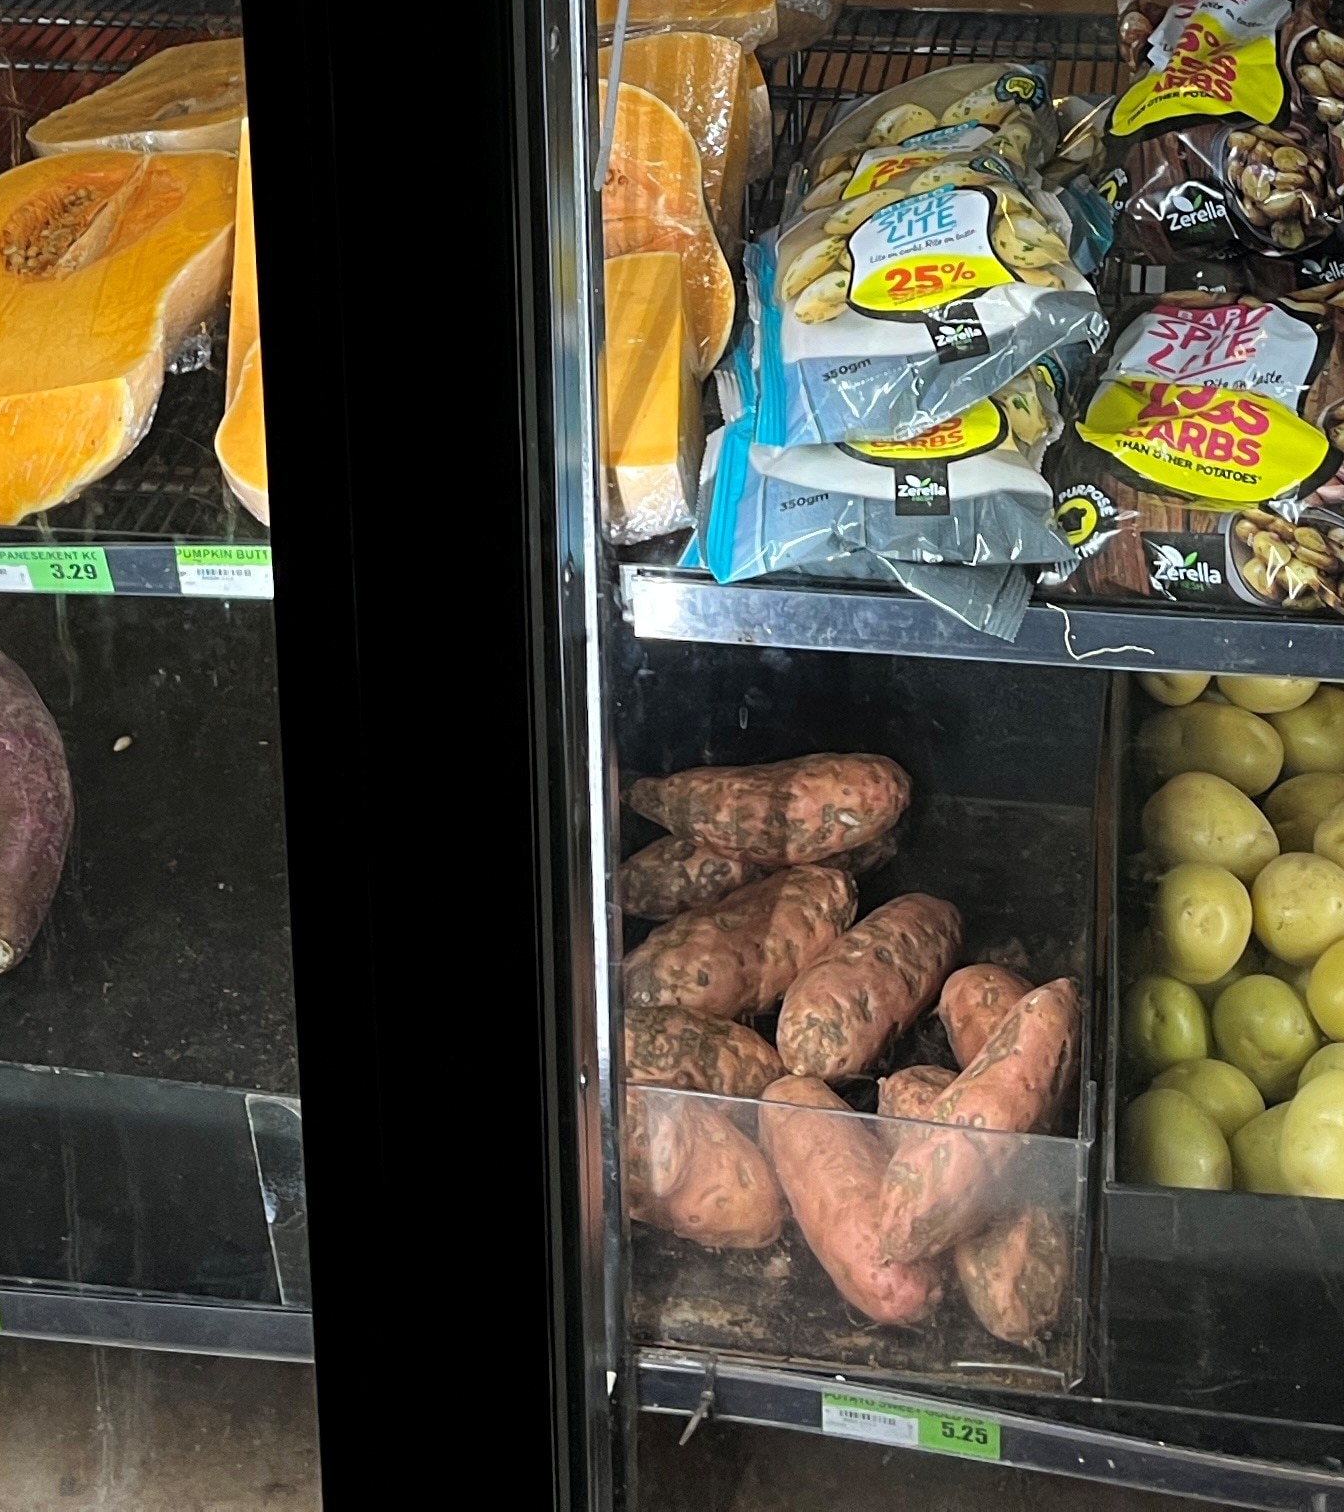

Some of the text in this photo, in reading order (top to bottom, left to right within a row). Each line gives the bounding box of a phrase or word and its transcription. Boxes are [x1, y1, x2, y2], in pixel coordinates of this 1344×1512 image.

[876, 193, 957, 234] SPUD
[886, 205, 958, 244] LITE
[1166, 201, 1227, 232] Zerella
[884, 261, 976, 293] 25%
[1115, 439, 1150, 459] THAN
[779, 491, 830, 512] 350gm
[898, 483, 947, 496] Zerella
[1058, 484, 1116, 518] PURPOSE
[177, 549, 233, 559] PUMPKIN
[50, 563, 98, 580] 3.29
[1153, 559, 1222, 584] Zerella
[941, 1420, 989, 1445] 5.25
